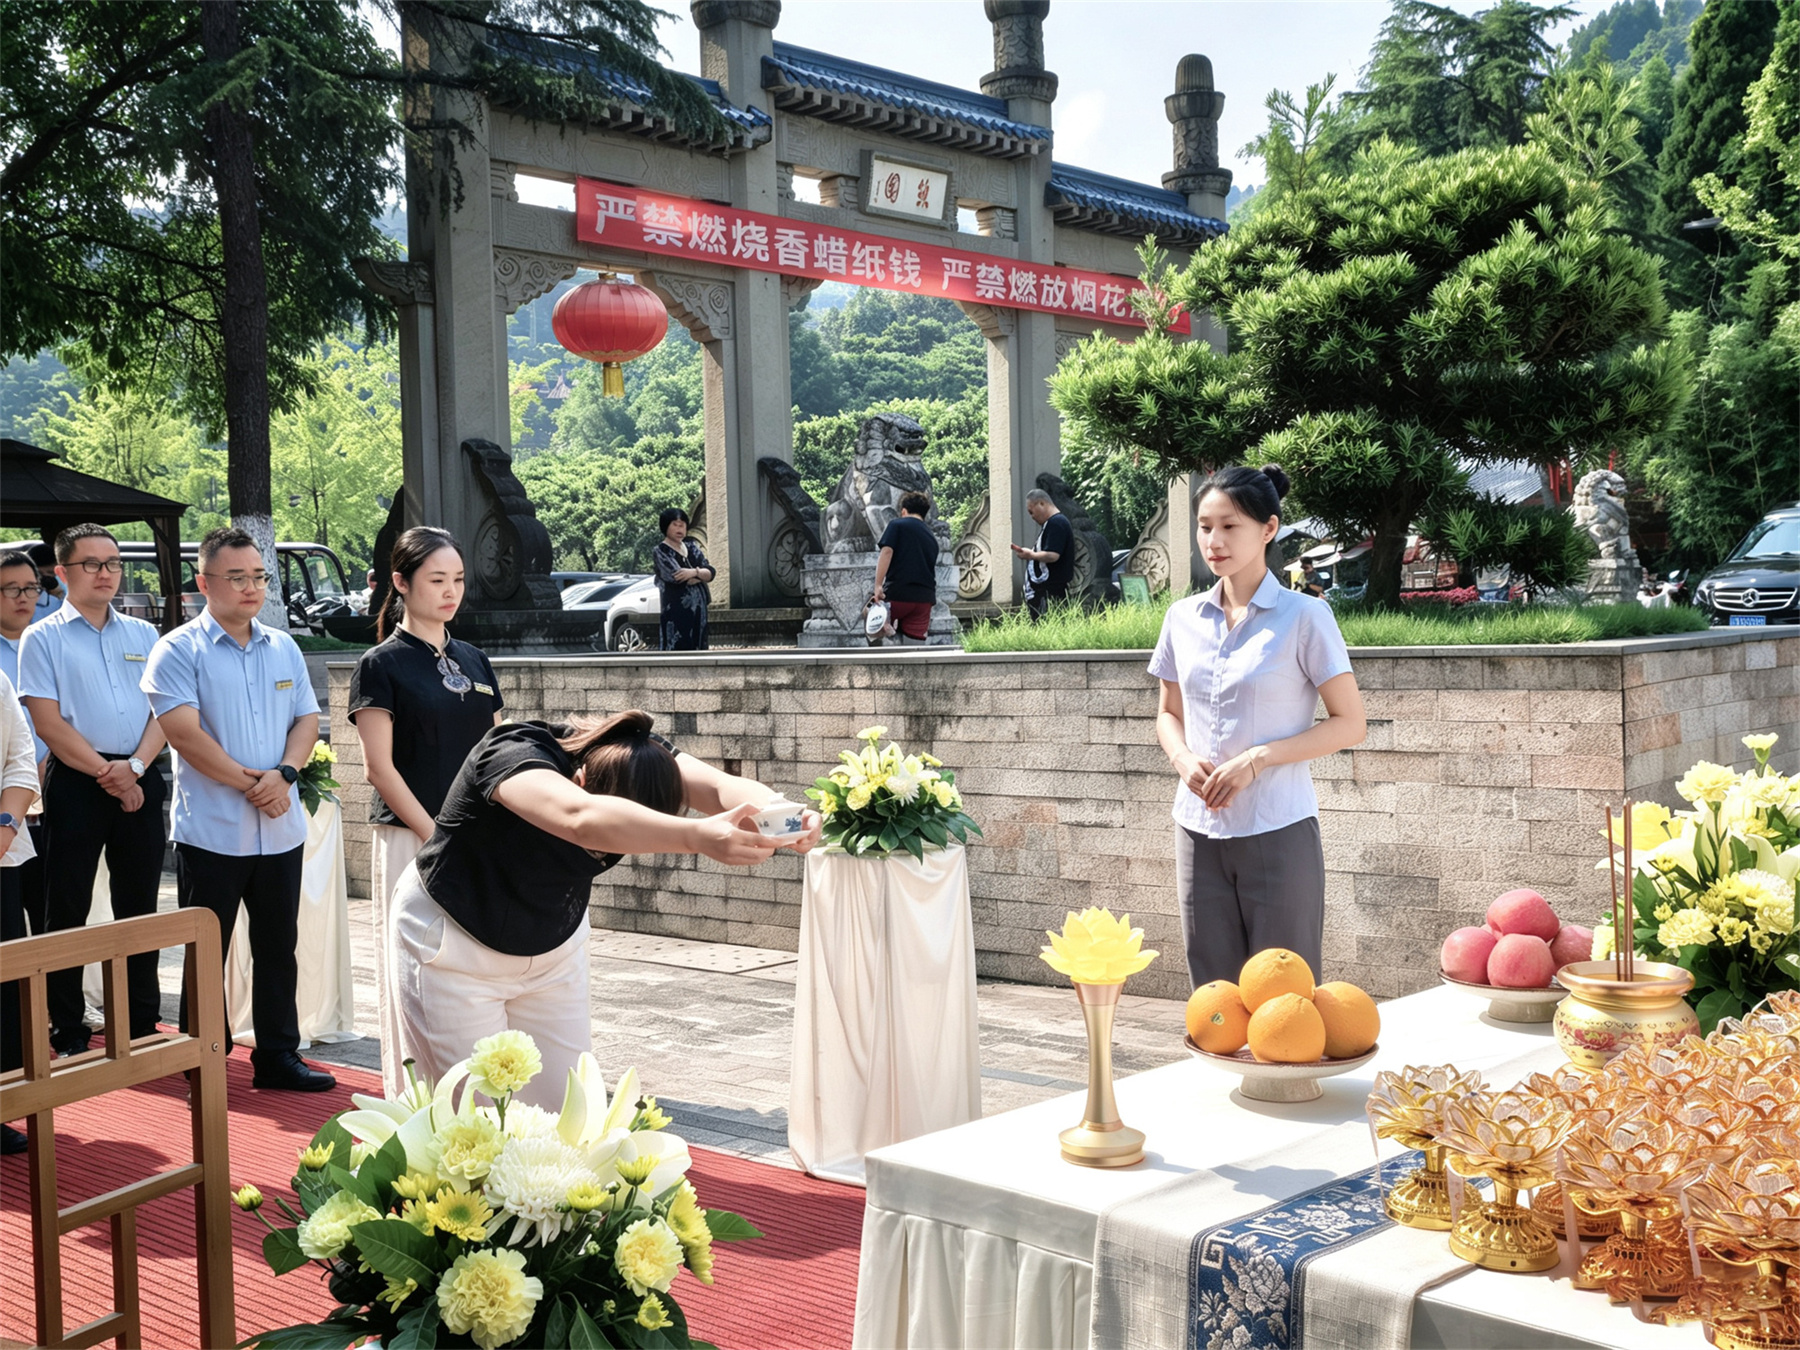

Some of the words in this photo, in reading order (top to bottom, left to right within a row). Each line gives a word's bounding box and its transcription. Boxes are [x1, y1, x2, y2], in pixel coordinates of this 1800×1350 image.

[595, 193, 922, 288] 严禁燃烧香蜡纸钱
[942, 257, 1178, 324] 严禁燃放烟花
